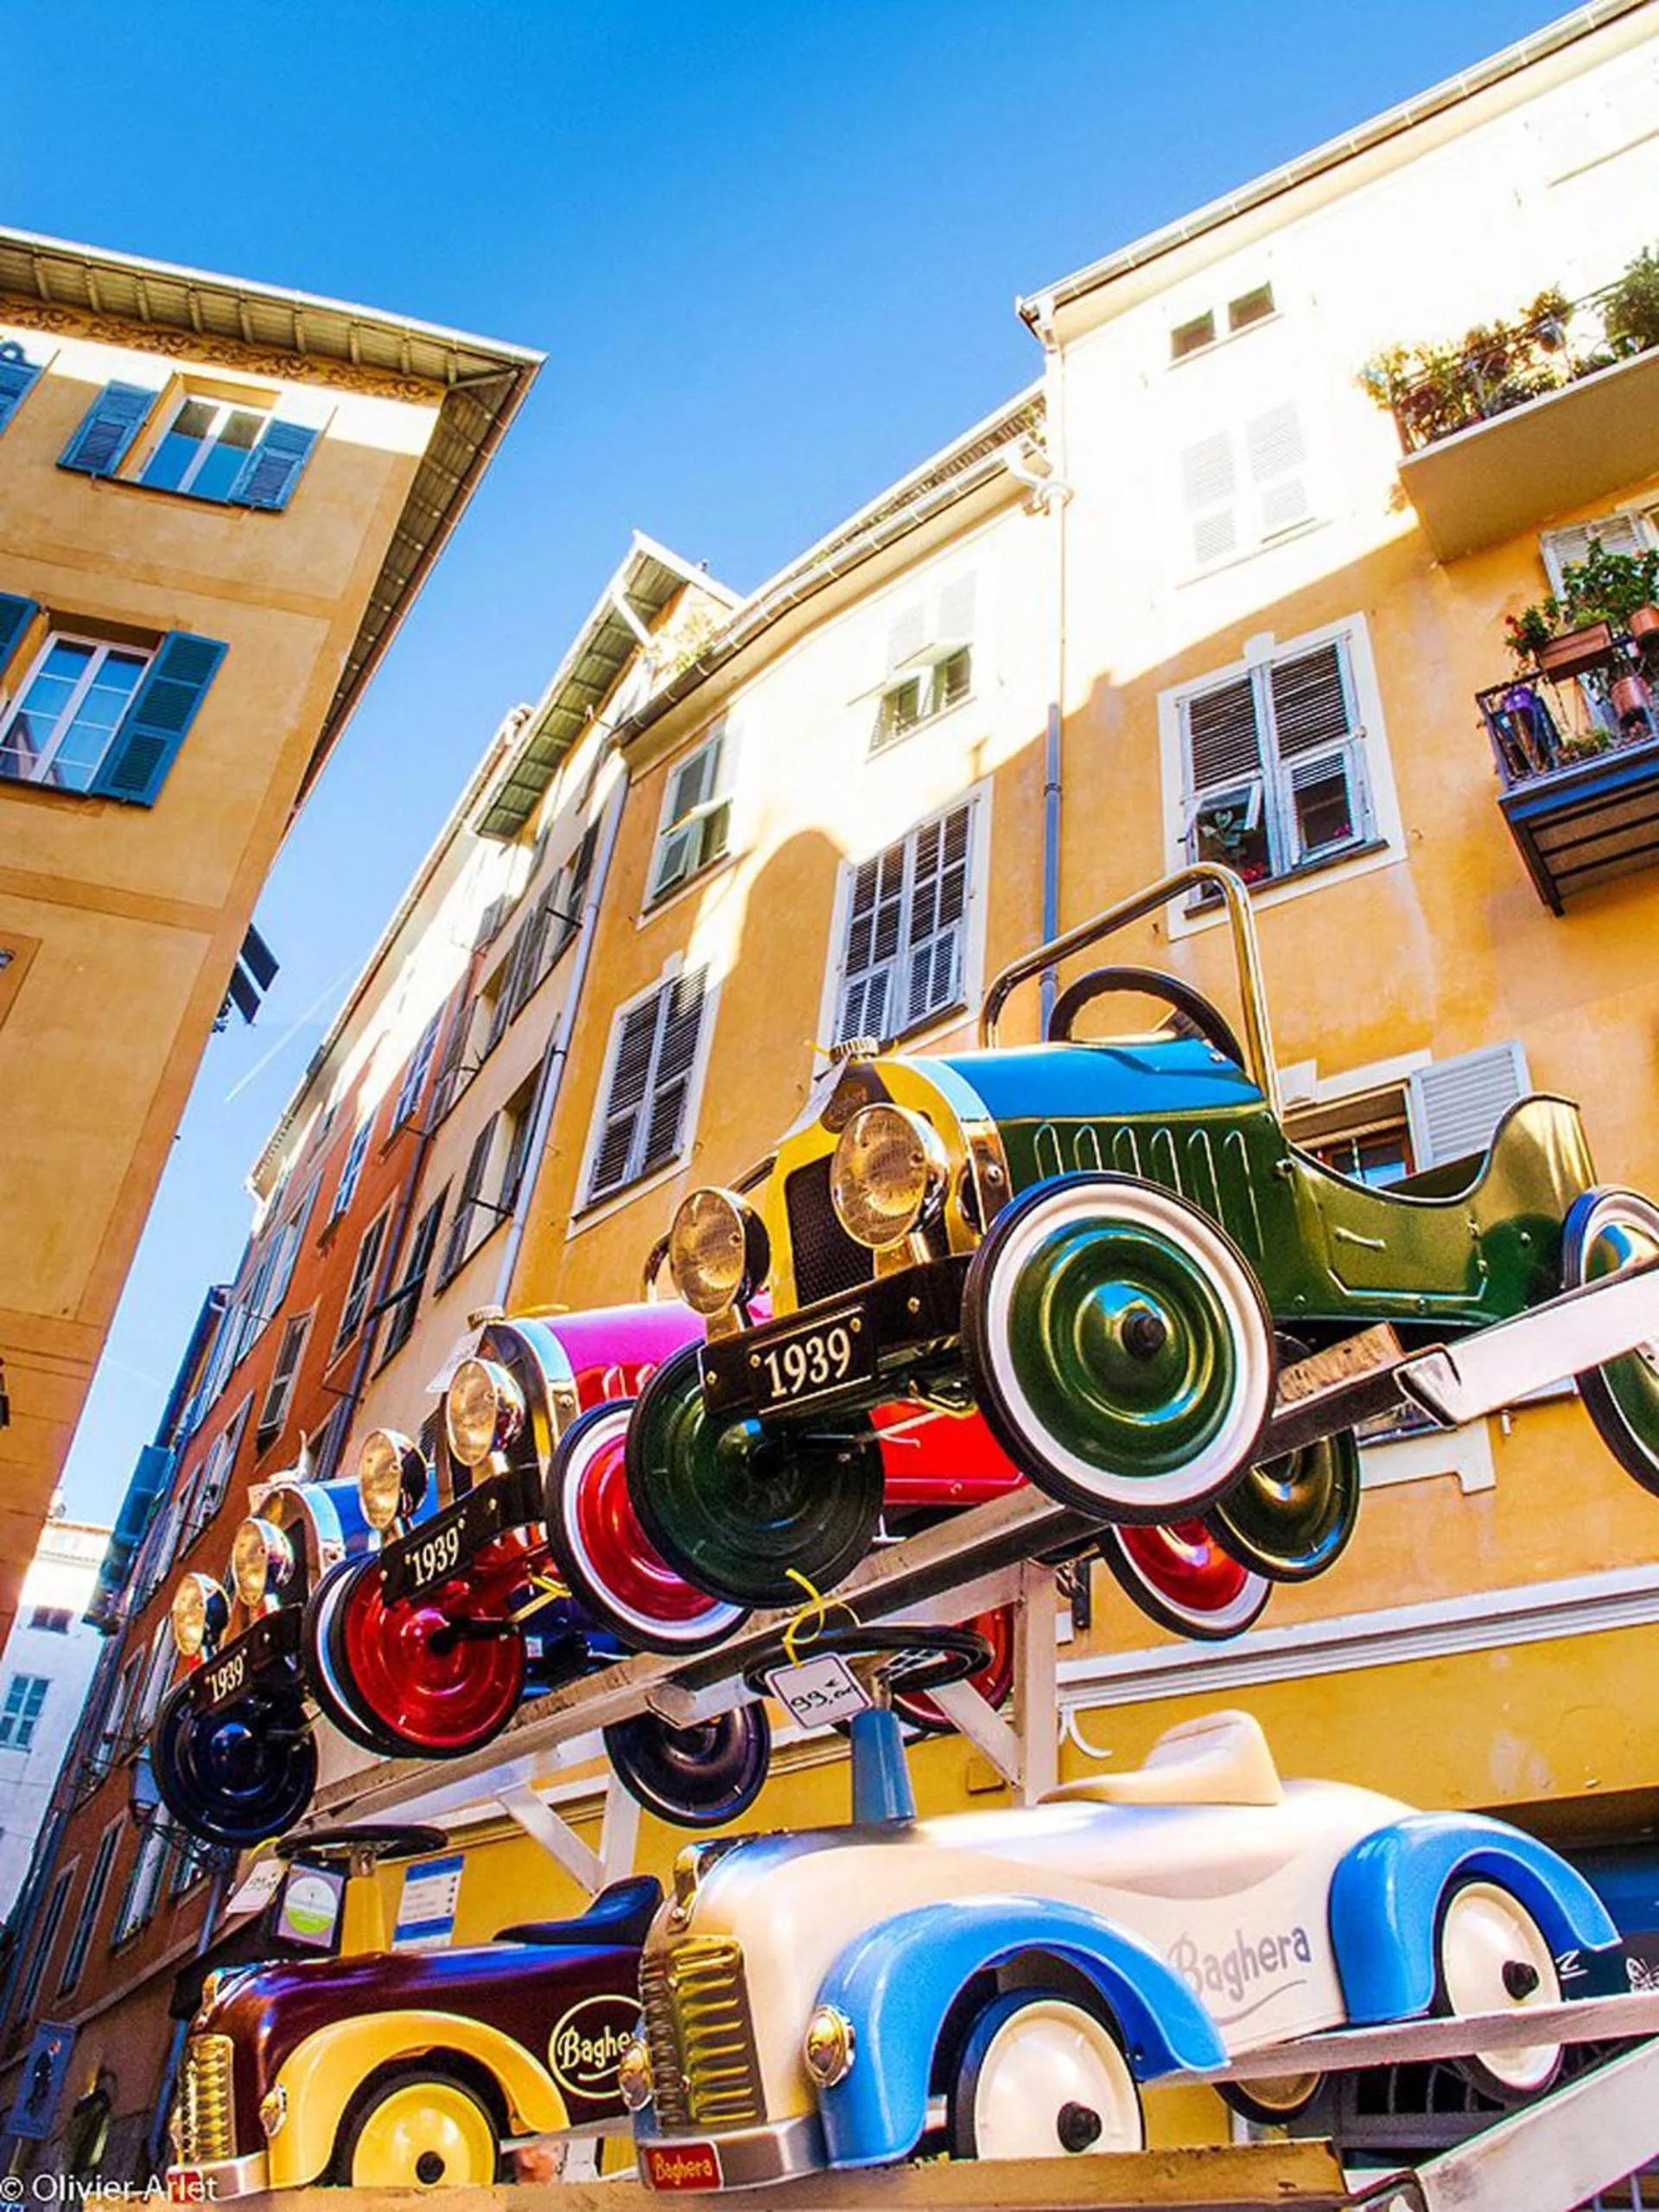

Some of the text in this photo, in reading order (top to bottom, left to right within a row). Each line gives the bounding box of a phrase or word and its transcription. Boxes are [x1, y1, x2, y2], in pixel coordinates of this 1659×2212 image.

[764, 1328, 851, 1397] 1939
[412, 1526, 459, 1586] 1939
[212, 1655, 244, 1702] 1939
[1167, 1927, 1312, 2001] Baghera
[557, 2024, 633, 2070] Baghe
[652, 2152, 713, 2185] Baghera
